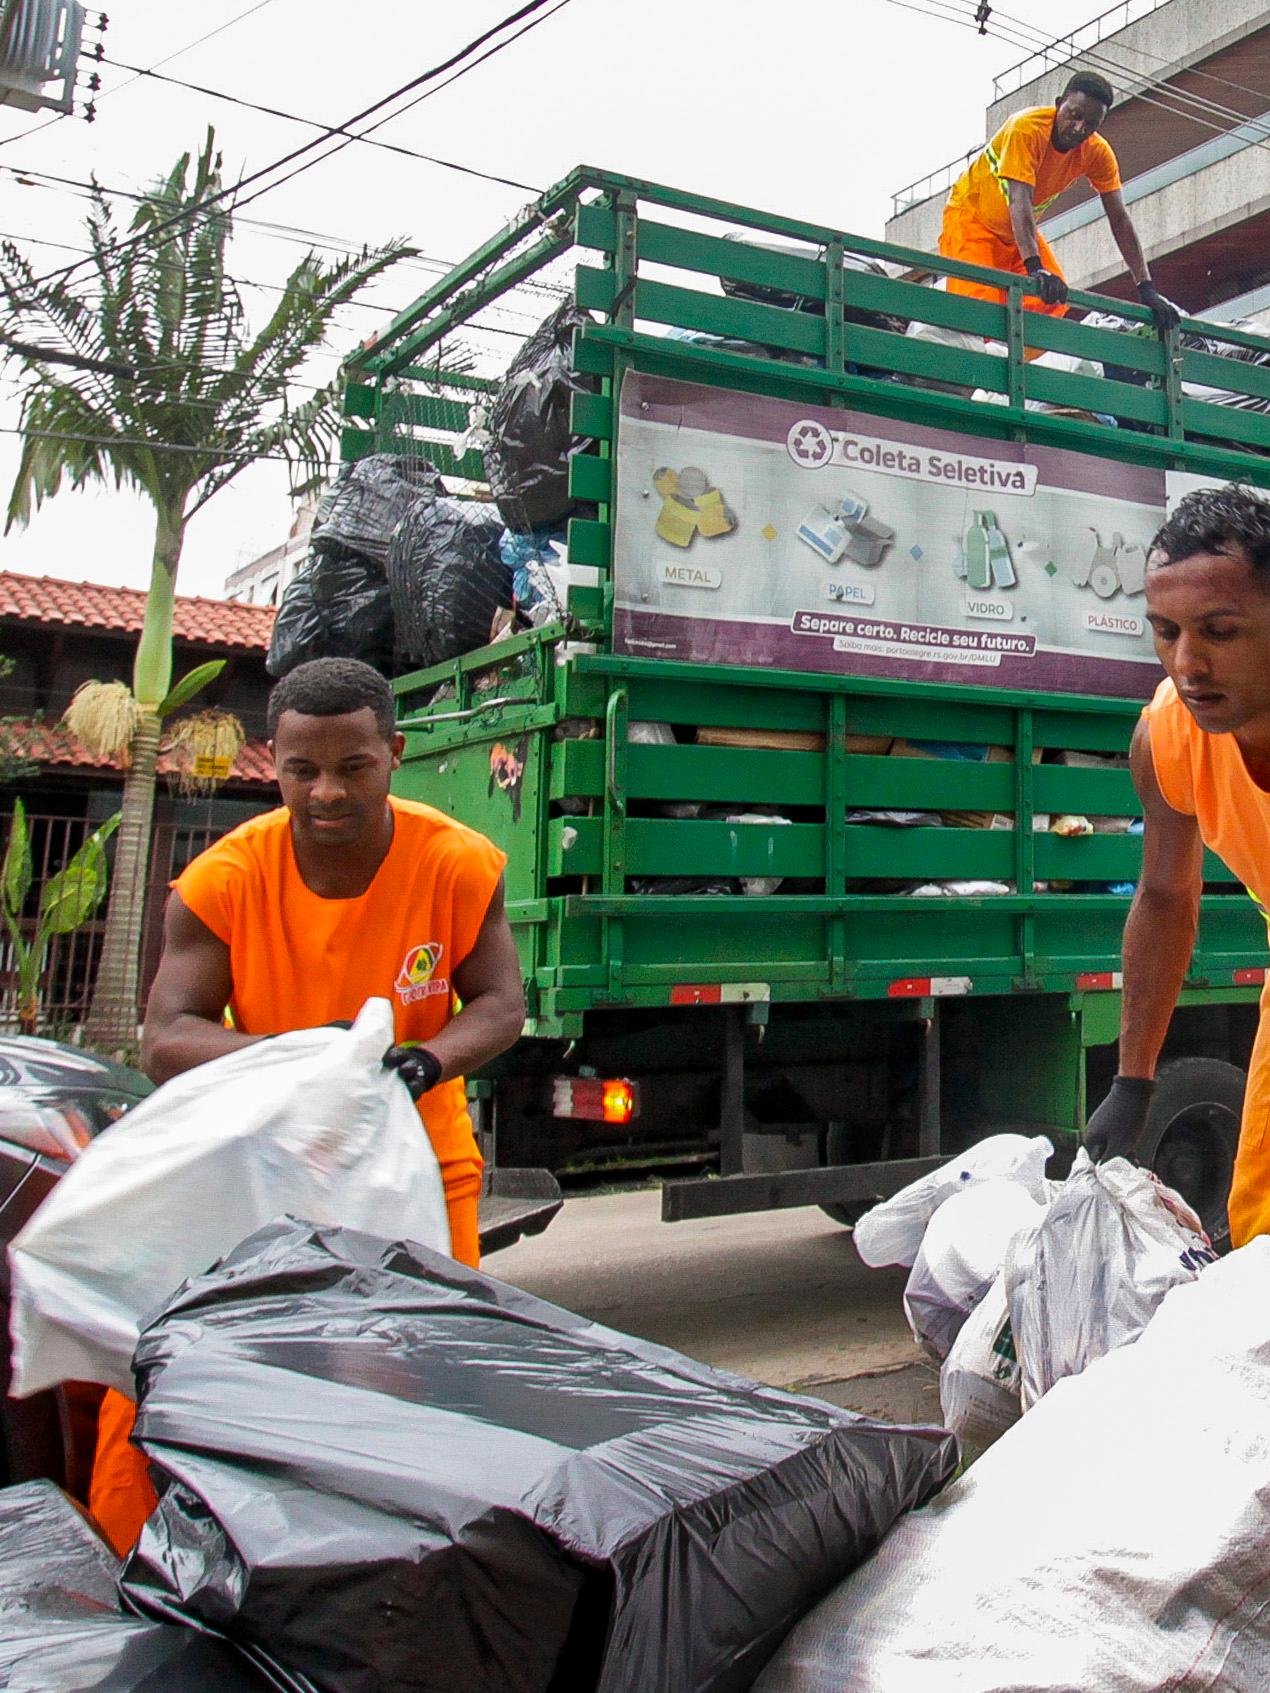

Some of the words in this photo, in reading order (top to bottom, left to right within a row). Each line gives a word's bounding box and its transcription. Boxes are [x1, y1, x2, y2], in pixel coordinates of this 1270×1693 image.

[842, 439, 920, 474] Coleta
[927, 455, 1026, 490] Seletiva
[665, 566, 712, 583] METAL
[828, 583, 867, 599] PAPEL
[967, 601, 1005, 615] VIDRO
[1088, 614, 1138, 631] PLÁSTICO
[800, 615, 854, 633] Separe
[857, 623, 898, 639] certo.
[900, 627, 950, 645] Recicle
[952, 634, 978, 647] seu
[980, 633, 1030, 651] futuro.
